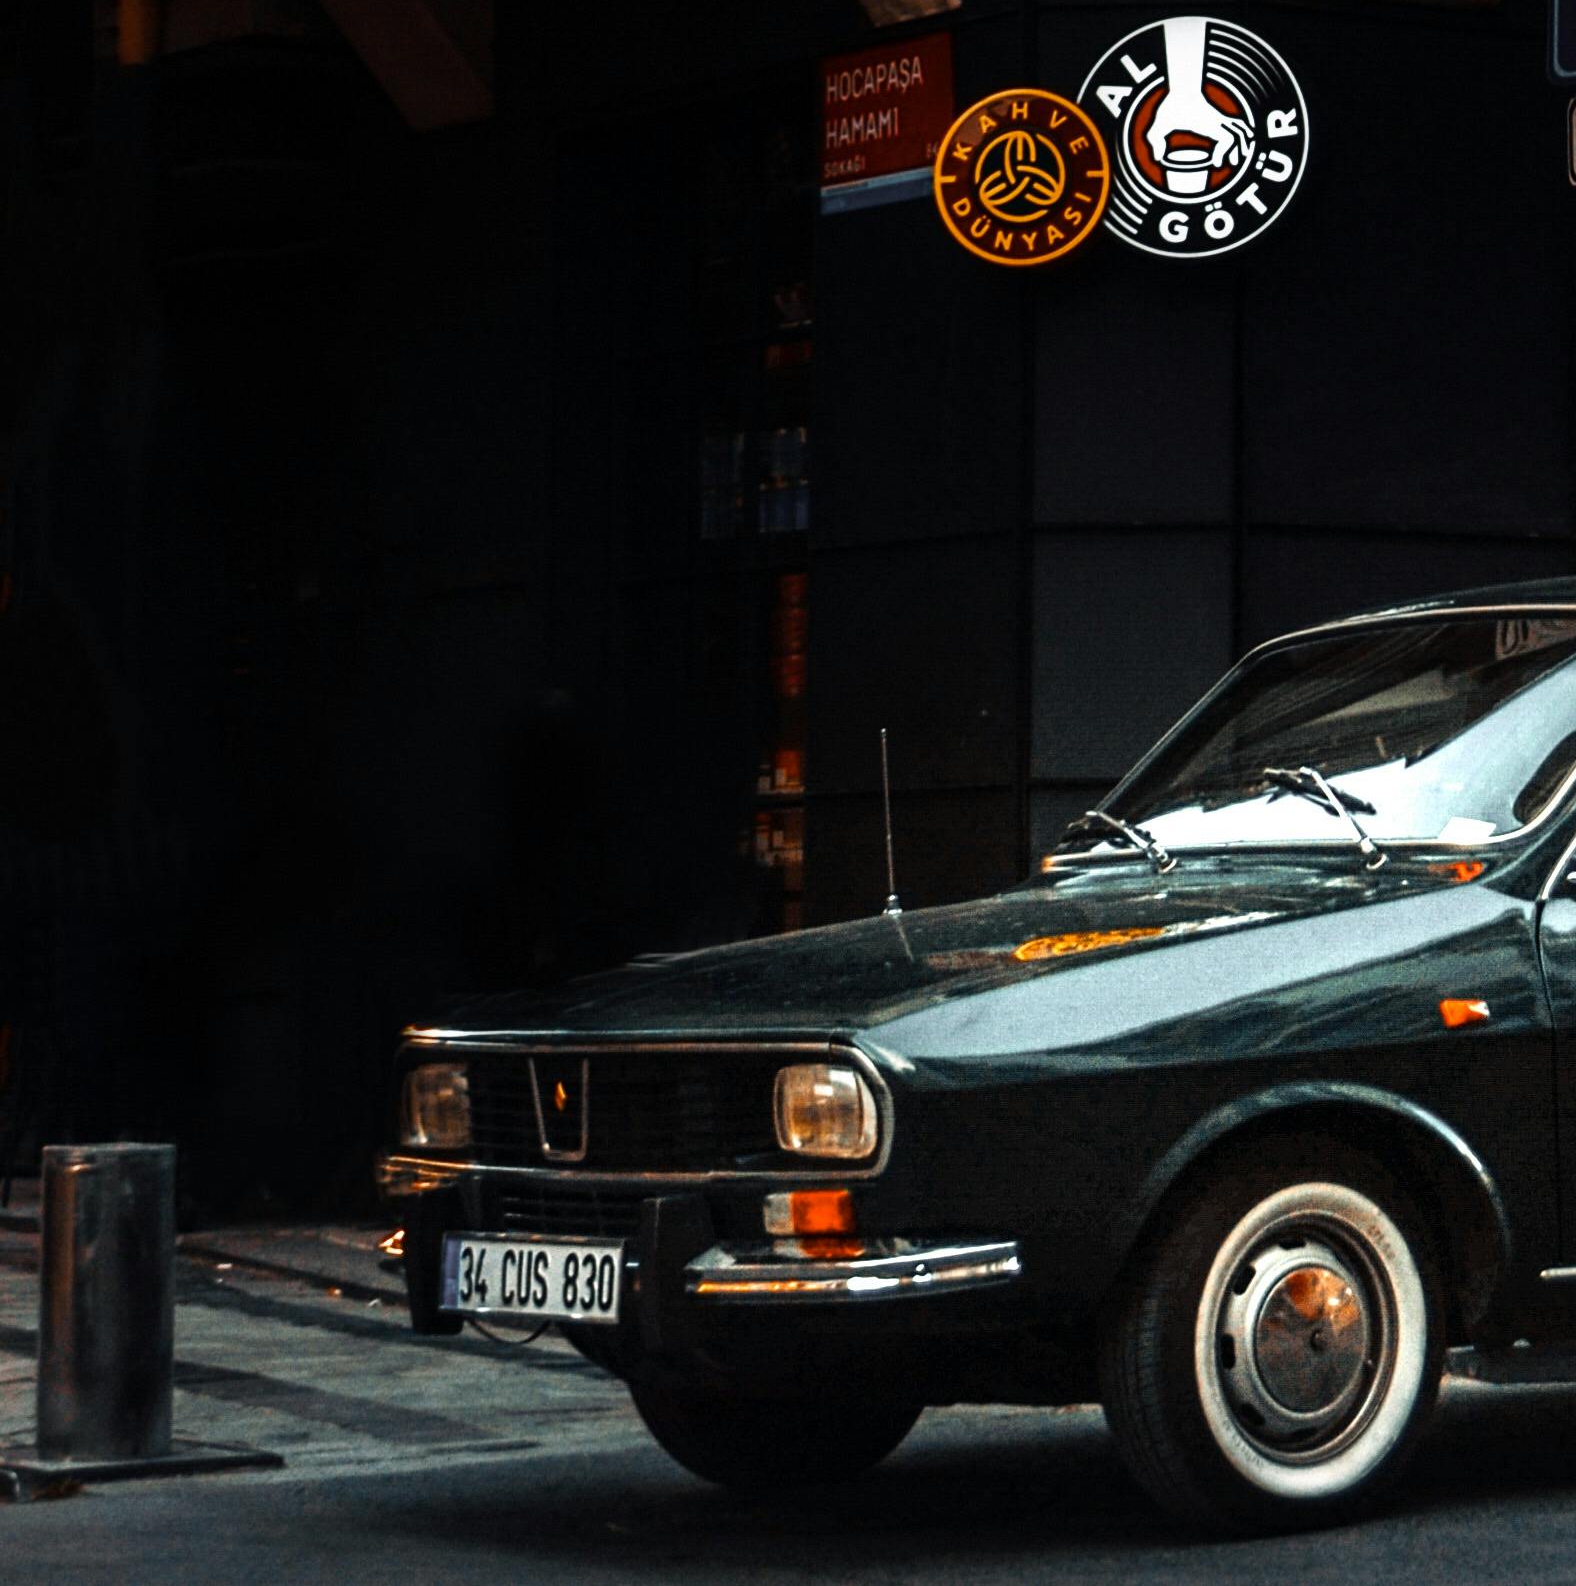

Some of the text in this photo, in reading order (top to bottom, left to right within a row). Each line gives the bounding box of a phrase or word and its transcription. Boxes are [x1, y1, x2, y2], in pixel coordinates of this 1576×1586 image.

[825, 55, 924, 104] HOCAPAŞA
[952, 101, 1089, 162] KAHVE
[1095, 54, 1298, 244] AL GÖTÜR
[823, 154, 866, 179] SOKAĞI
[951, 192, 1092, 252] DÜNYASI
[460, 1246, 615, 1312] 34 CUS 830
